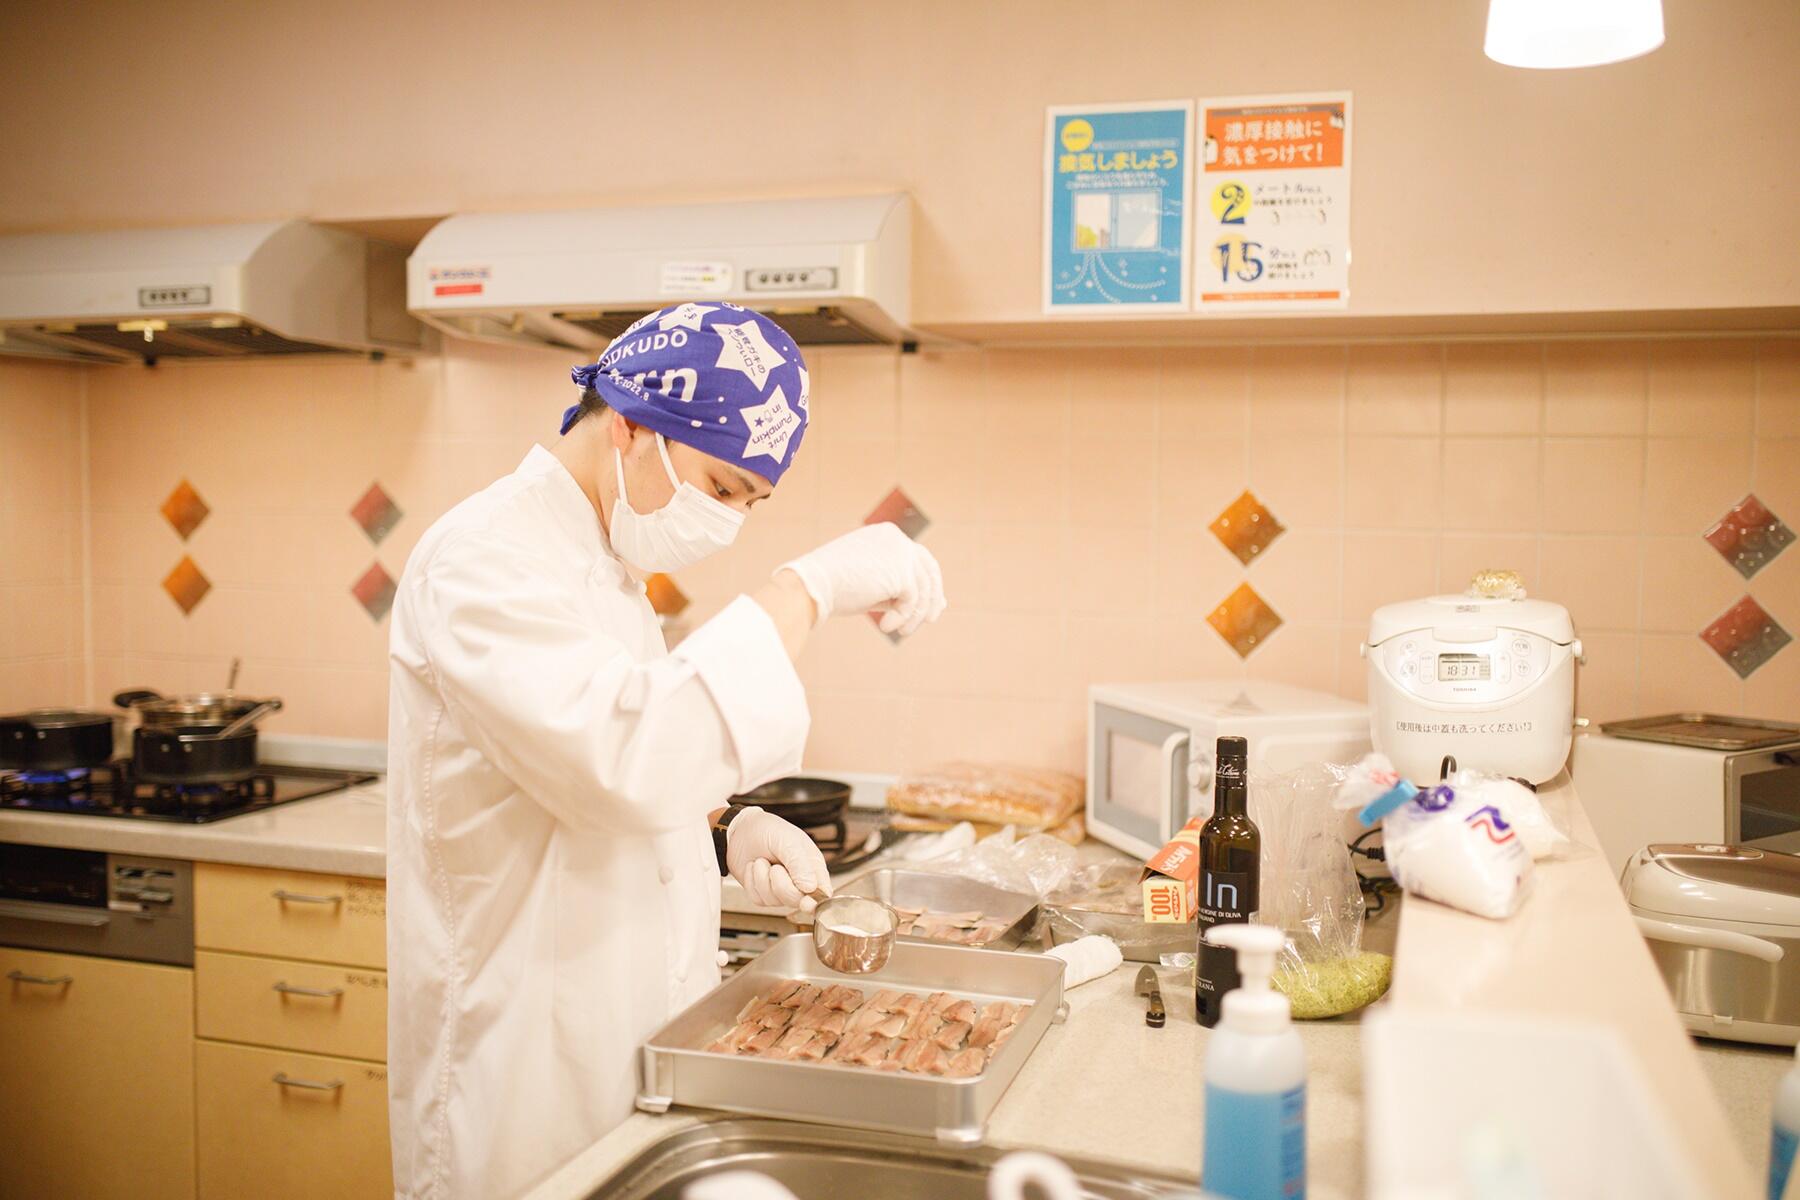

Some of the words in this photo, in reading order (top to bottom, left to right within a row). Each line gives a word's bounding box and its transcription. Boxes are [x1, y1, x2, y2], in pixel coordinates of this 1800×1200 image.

[1220, 183, 1246, 225] 2
[1216, 240, 1264, 283] 15
[751, 412, 793, 444] Pumpkin
[1150, 886, 1171, 916] 100
